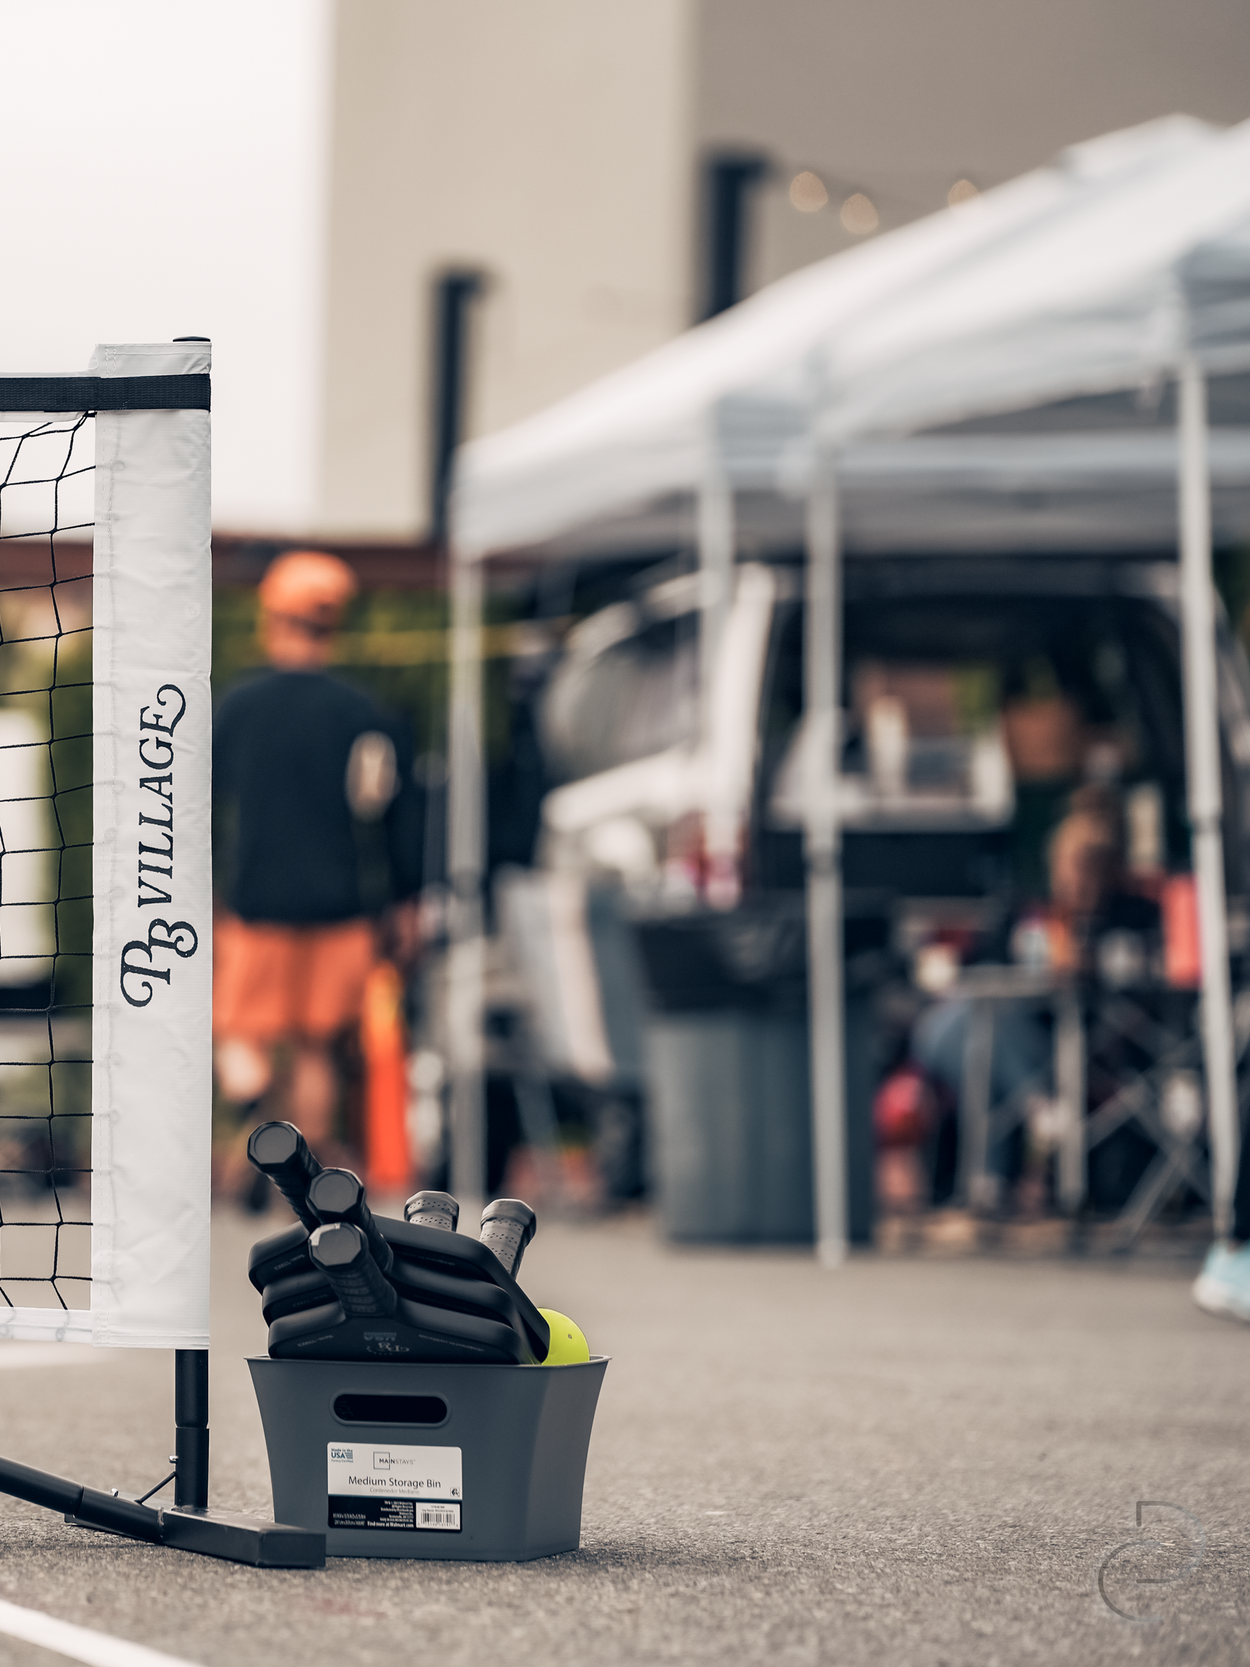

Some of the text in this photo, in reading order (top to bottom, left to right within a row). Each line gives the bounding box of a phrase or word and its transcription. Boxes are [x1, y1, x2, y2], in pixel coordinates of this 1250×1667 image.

[137, 683, 187, 908] VILLAGE
[348, 1476, 441, 1489] Medium Storage Bin
